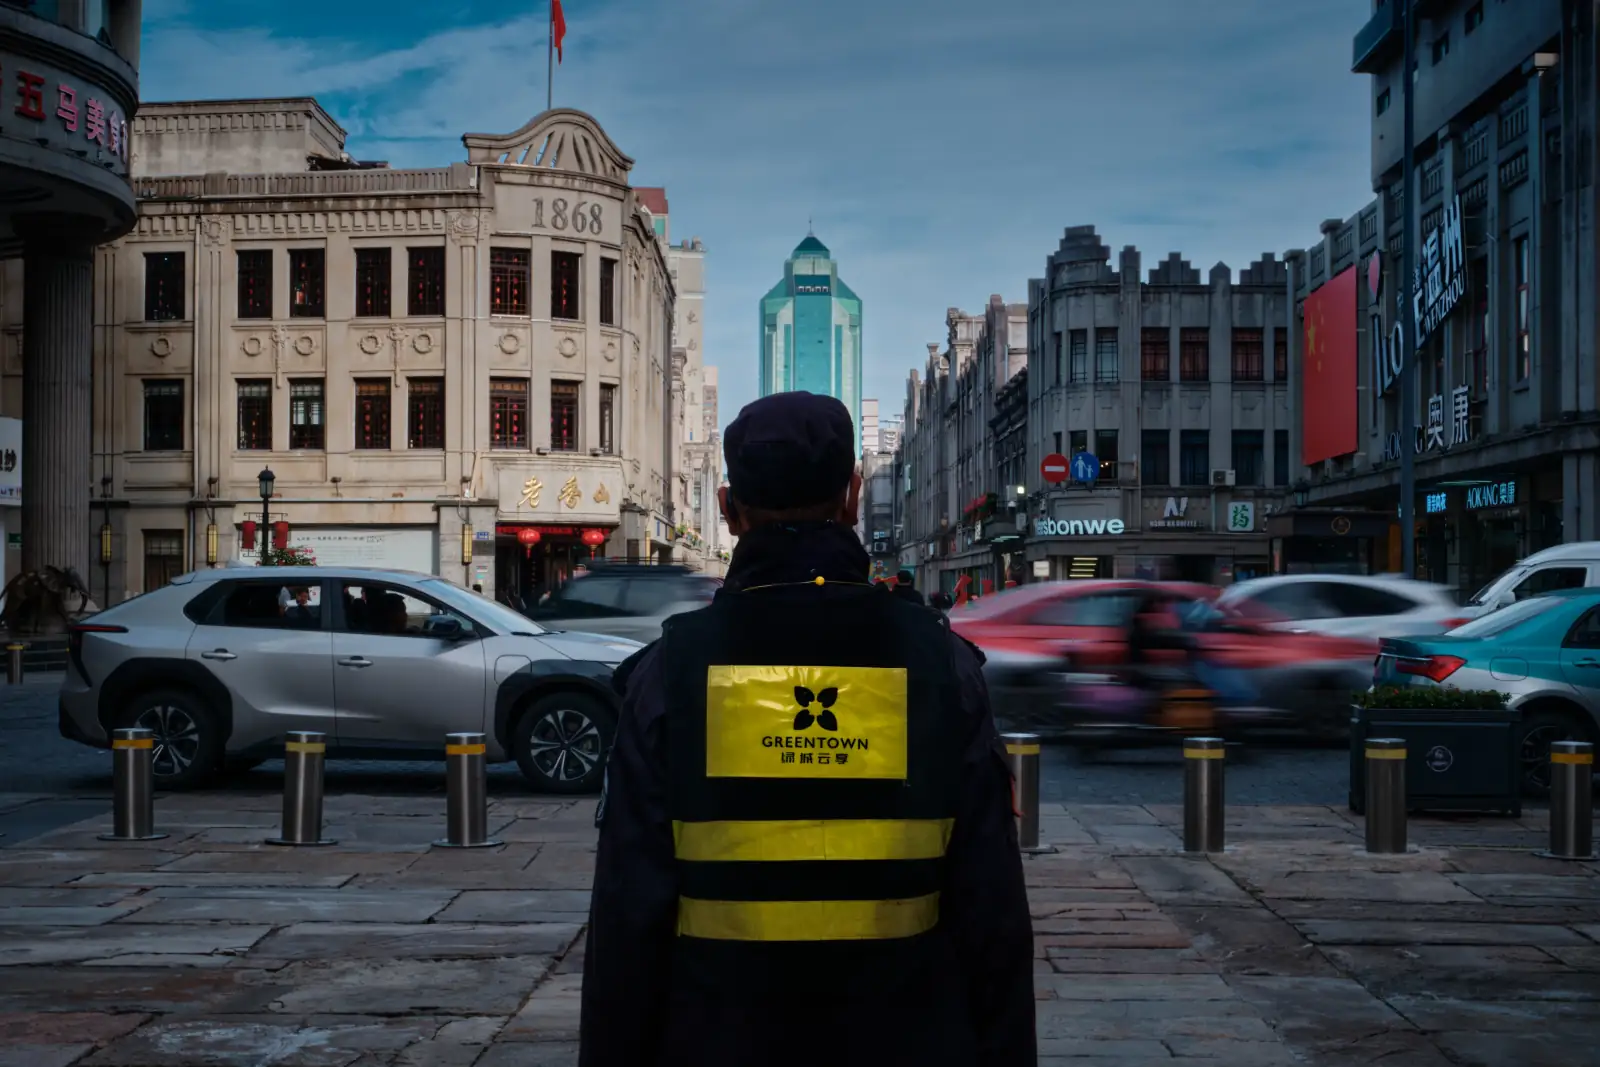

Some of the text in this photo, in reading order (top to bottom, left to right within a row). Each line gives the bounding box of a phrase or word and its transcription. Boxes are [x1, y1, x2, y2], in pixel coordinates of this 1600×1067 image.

[532, 197, 603, 235] 1868
[1423, 194, 1463, 309] 温州
[1424, 268, 1465, 336] WENZHOU
[1428, 384, 1470, 452] 奥康
[1466, 484, 1499, 509] AOKANG
[1500, 481, 1516, 504] 奥康
[762, 736, 868, 750] GREENTOWN
[781, 752, 849, 765] 绿城云享
